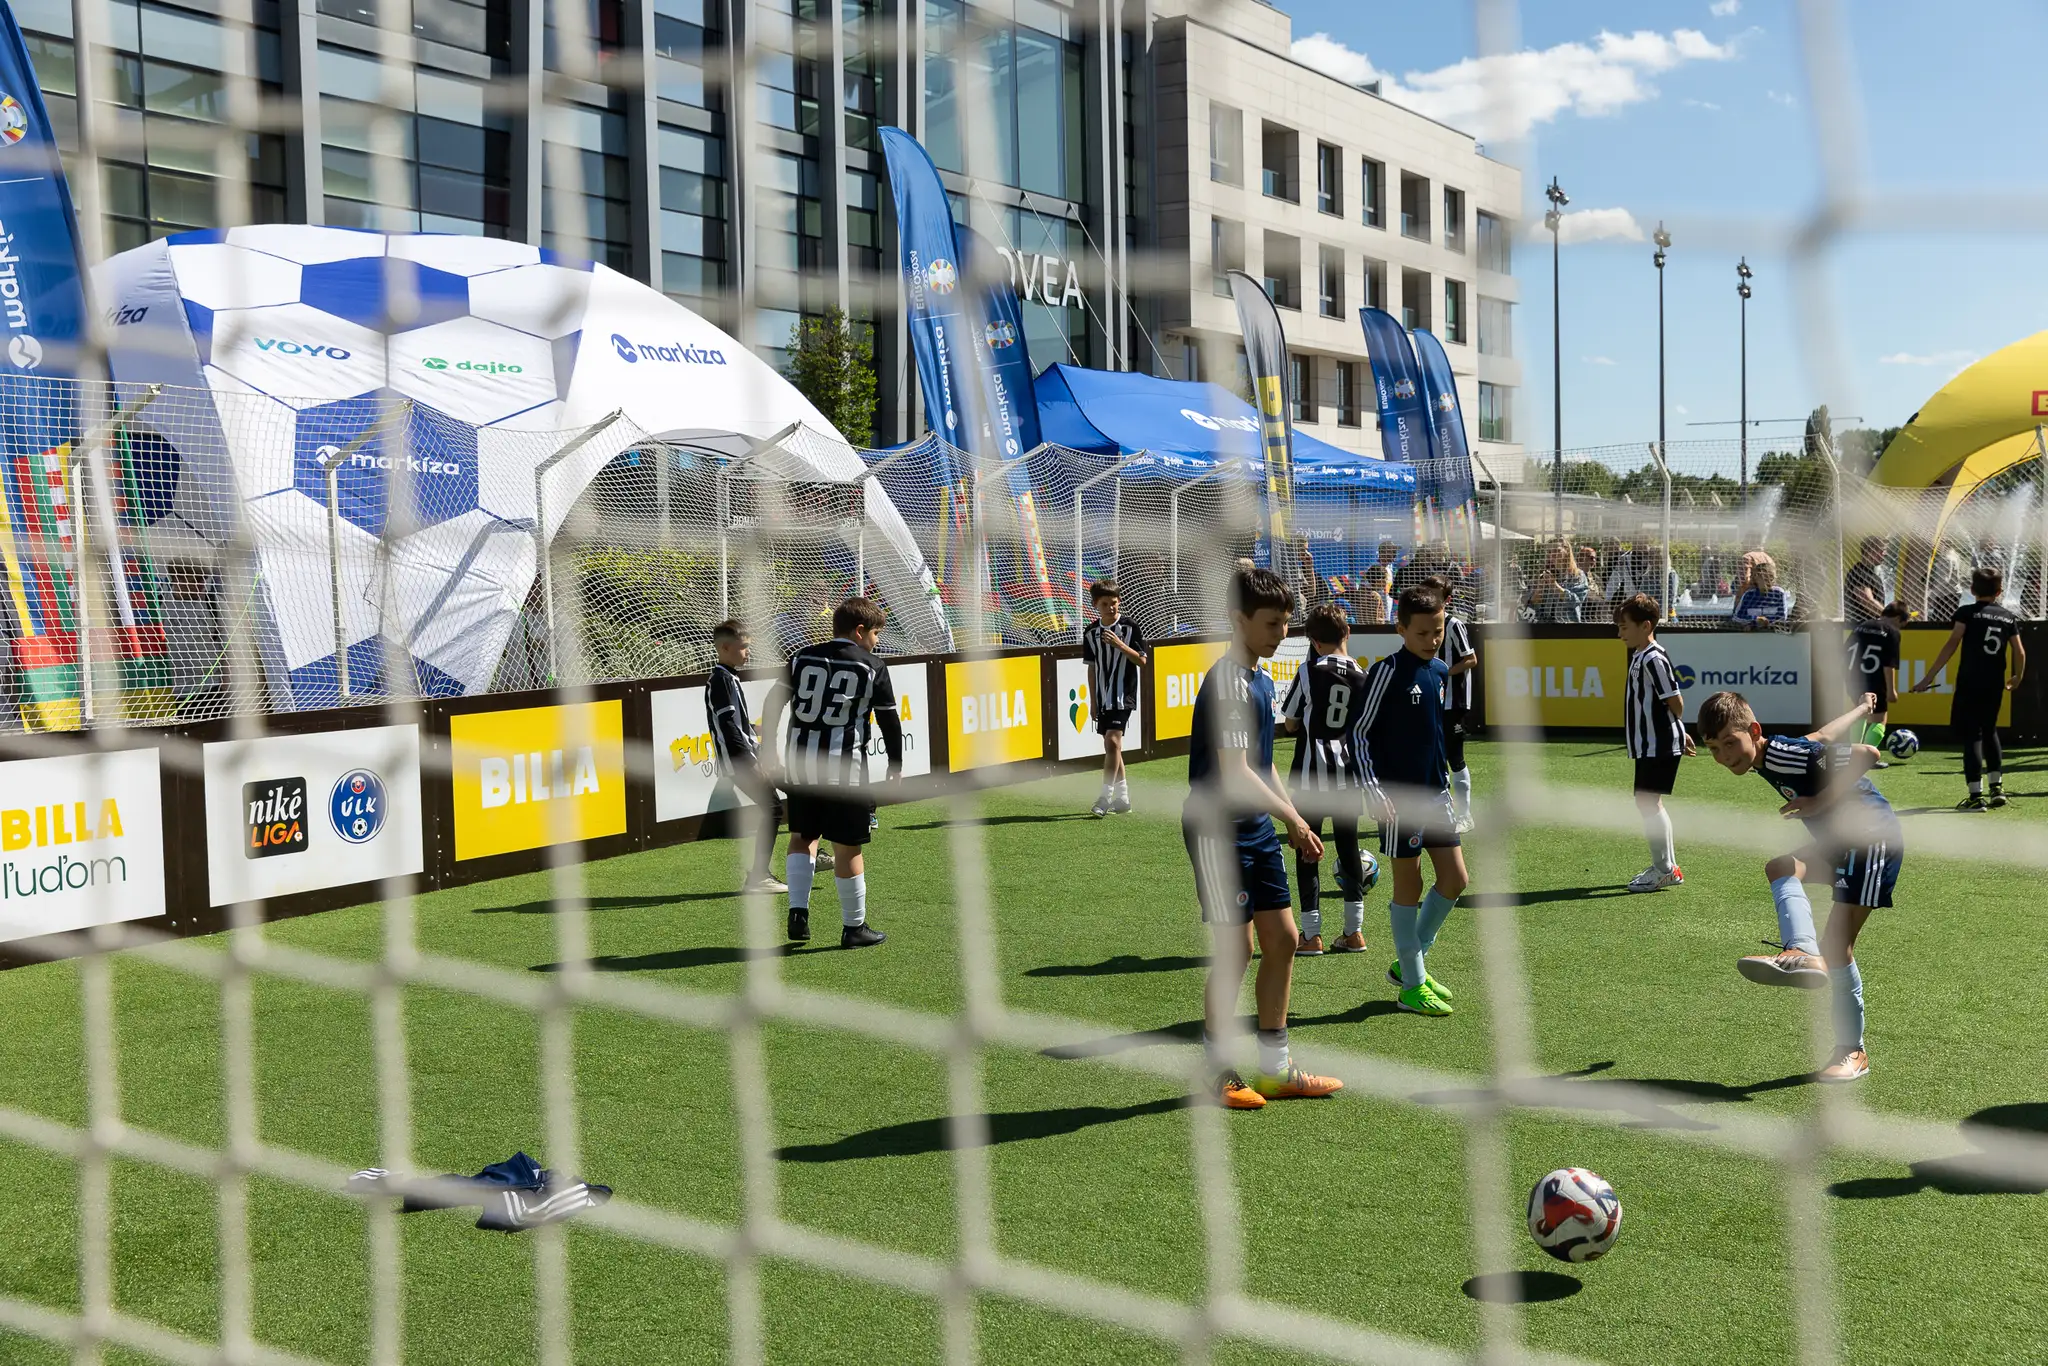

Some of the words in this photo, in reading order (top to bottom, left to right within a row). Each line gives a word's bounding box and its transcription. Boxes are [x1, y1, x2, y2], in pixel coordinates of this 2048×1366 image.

[253, 337, 351, 360] VOYO
[637, 342, 727, 365] markíza
[456, 360, 523, 374] dajto
[351, 452, 460, 475] markíza
[1983, 626, 2001, 655] 5
[1847, 642, 1882, 674] 15
[1506, 666, 1605, 698] BILLA
[1702, 665, 1798, 687] markíza
[795, 665, 859, 726] 93
[1326, 683, 1351, 729] 8
[1412, 694, 1421, 705] LT
[961, 689, 1028, 735] BILLA
[481, 746, 600, 810] BILLA
[249, 785, 302, 825] niké
[341, 796, 377, 818] ÚLK
[1, 797, 125, 853] BILLA
[251, 820, 303, 849] LIGA
[3, 854, 127, 900] ľuďom
